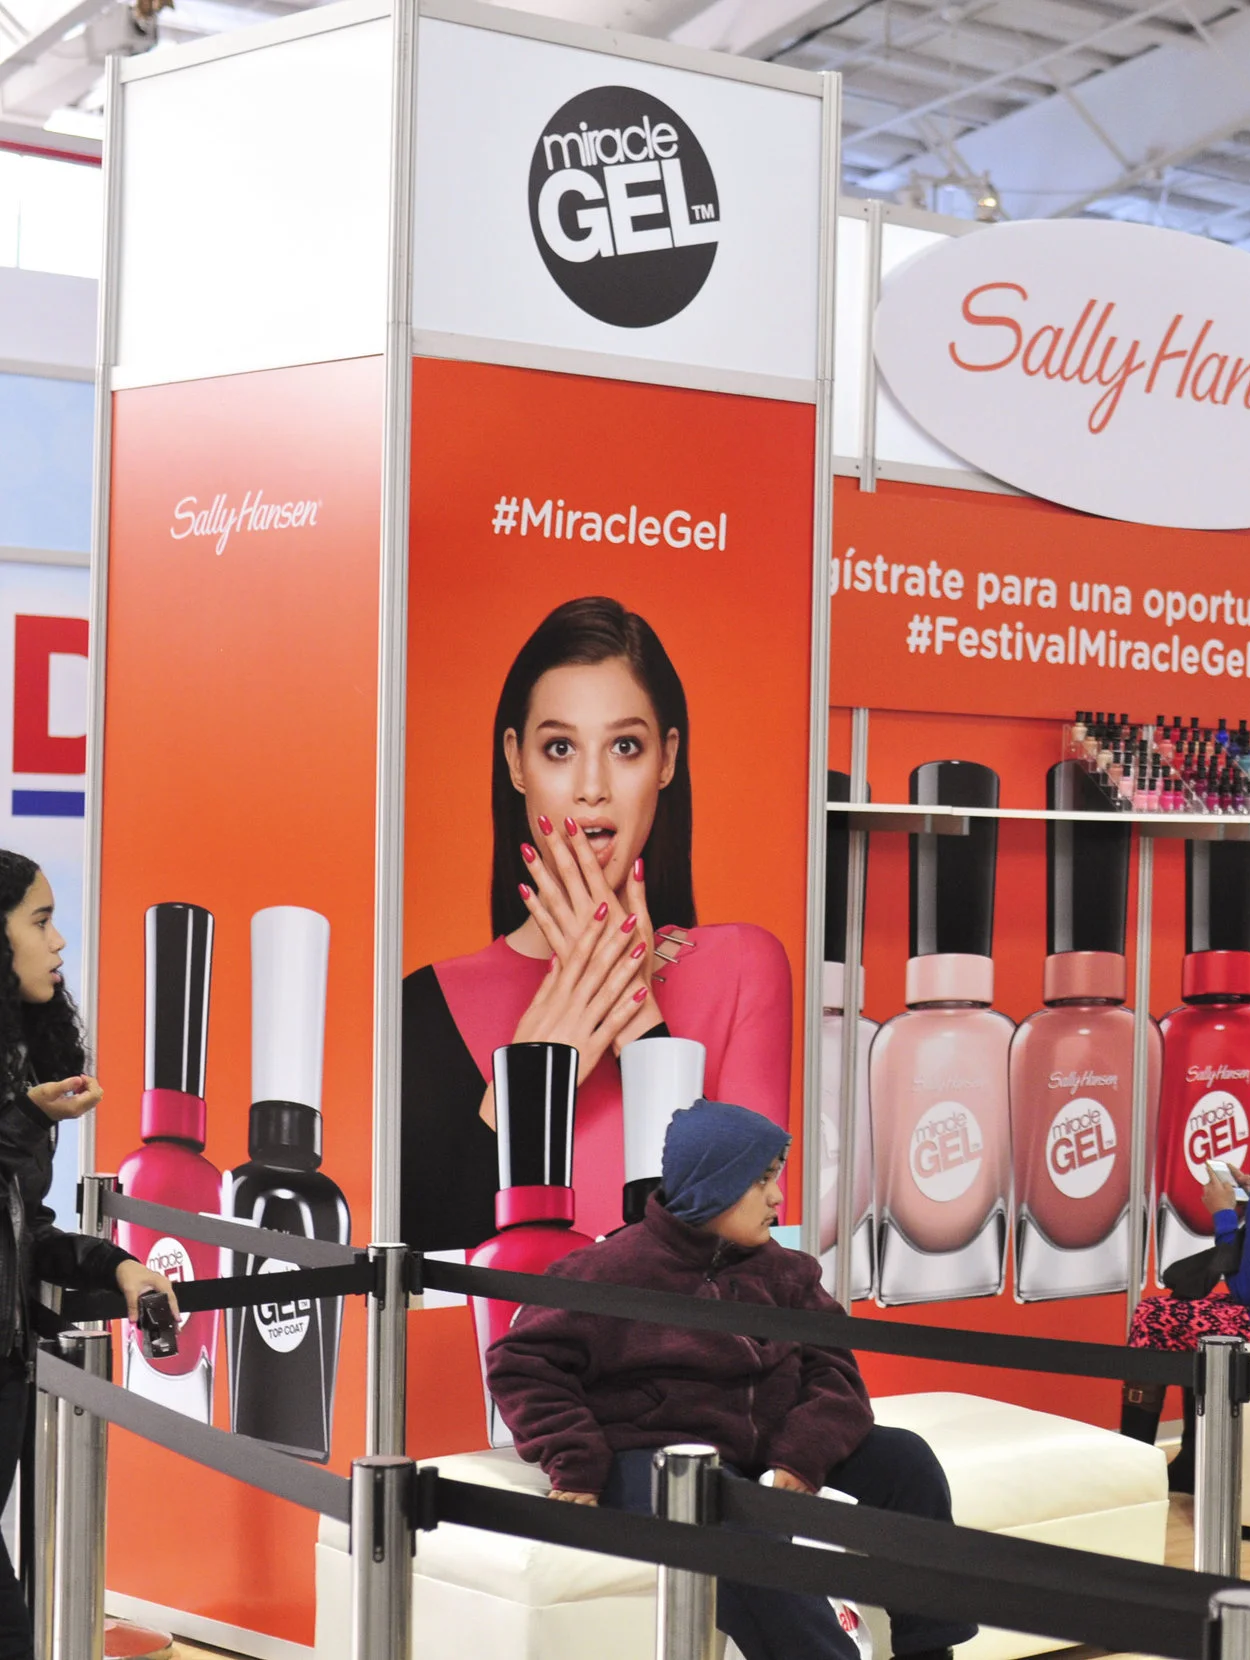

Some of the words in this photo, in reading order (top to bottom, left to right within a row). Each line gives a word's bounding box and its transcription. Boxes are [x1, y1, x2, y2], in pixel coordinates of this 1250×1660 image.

[543, 115, 679, 170] miracle
[538, 158, 720, 263] GEL
[492, 495, 727, 551] #MiracleGel
[977, 572, 1058, 610] para
[1070, 581, 1132, 615] una
[915, 1111, 968, 1143] miracle
[1051, 1108, 1101, 1140] miracle
[1189, 1116, 1249, 1165] GEL
[1190, 1101, 1235, 1131] miracle
[913, 1125, 983, 1178] GEL
[1050, 1124, 1117, 1175] GEL
[268, 1327, 283, 1339] TOP
[283, 1322, 304, 1336] COAT
